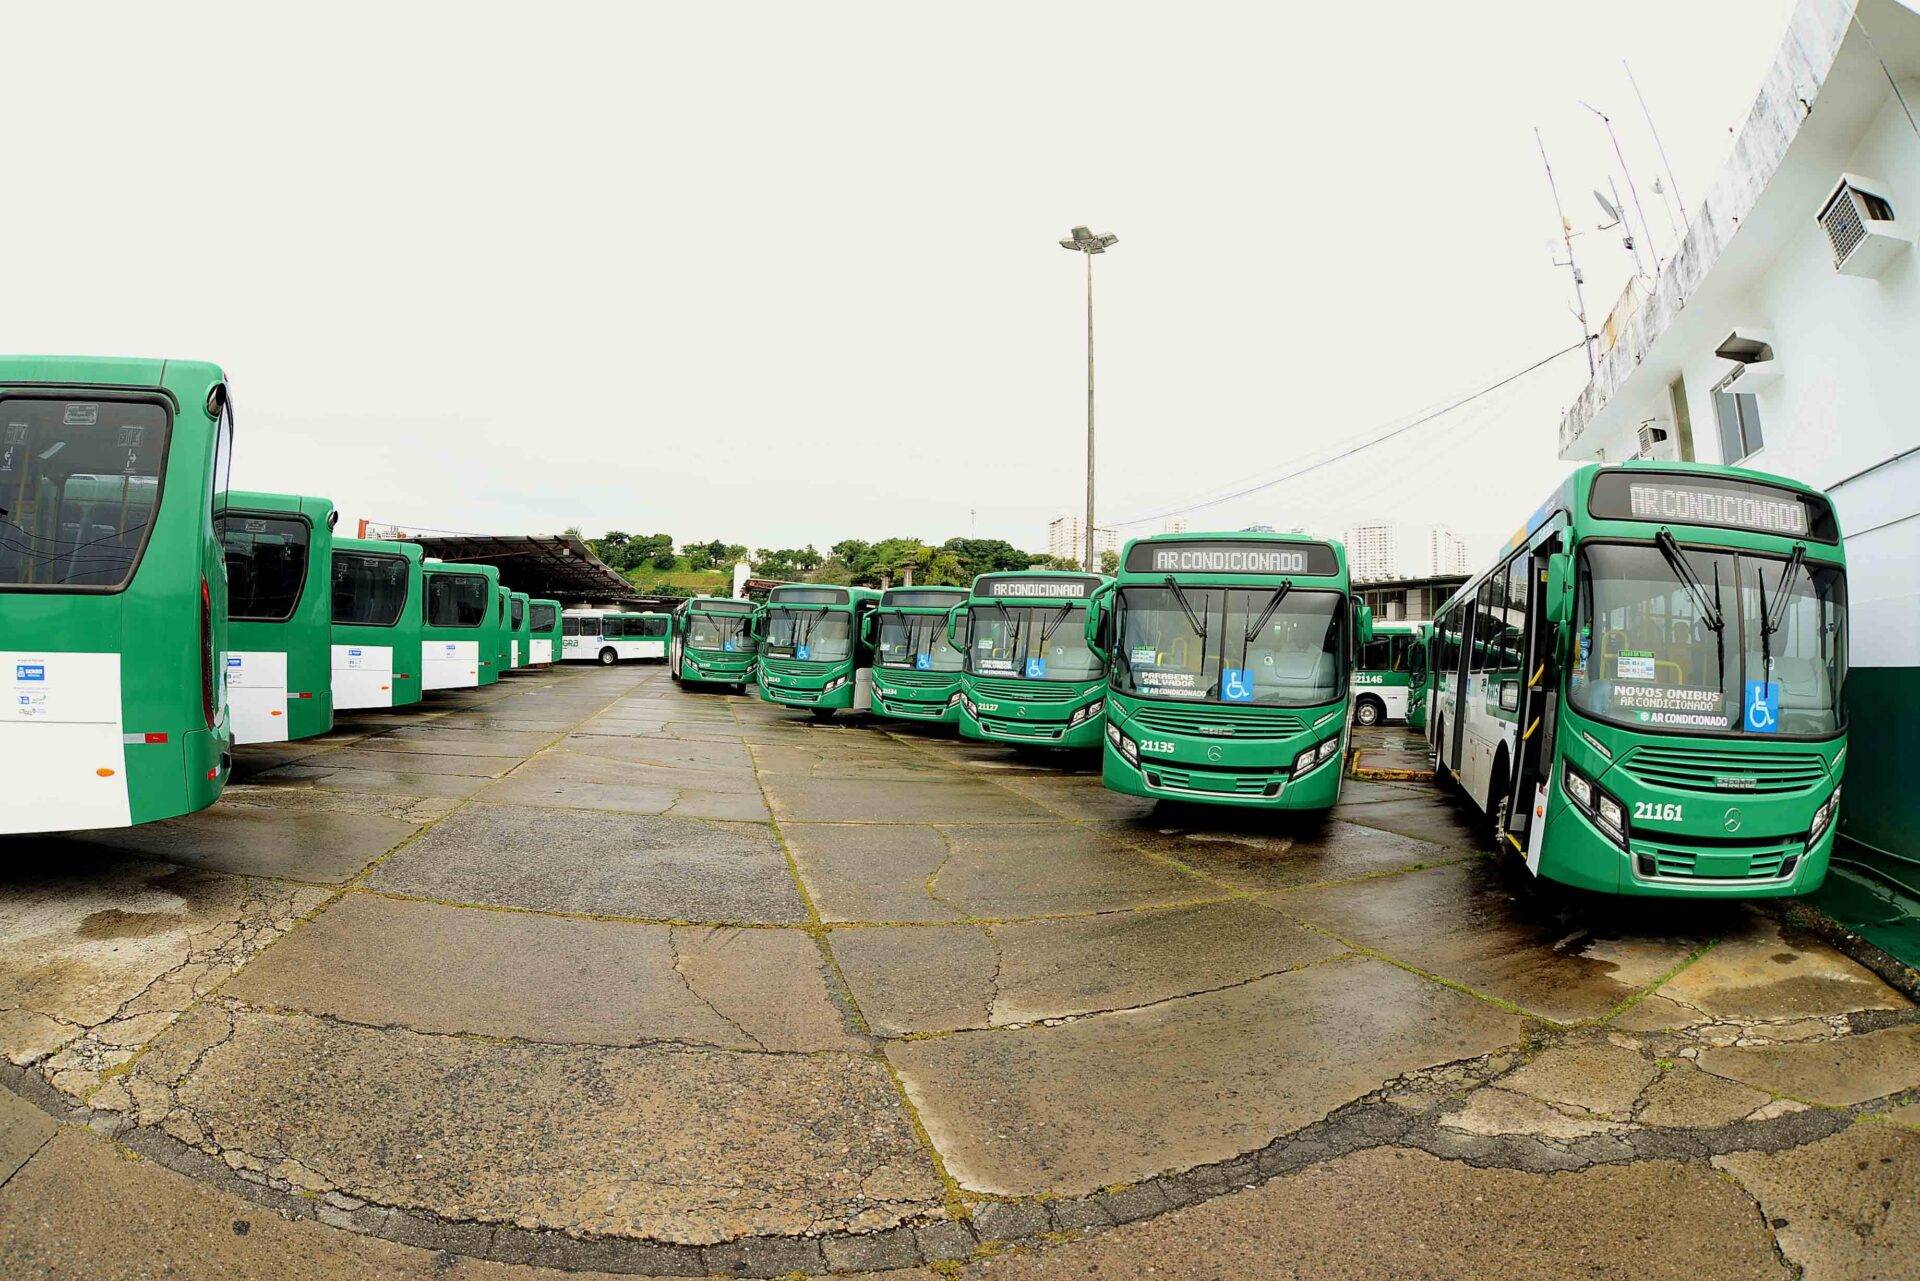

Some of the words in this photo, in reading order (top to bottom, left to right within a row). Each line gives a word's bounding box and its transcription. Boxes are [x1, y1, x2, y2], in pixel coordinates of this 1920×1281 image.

[1630, 486, 1659, 515] AR
[1662, 489, 1802, 531] CONDICIONADO
[1157, 551, 1179, 569] AR
[1181, 551, 1303, 571] CONDICIONADO
[993, 583, 1007, 596] AR
[1008, 584, 1085, 597] CONDICIONADO
[1141, 671, 1195, 681] PARABENS
[1143, 679, 1196, 688] SALVADOR
[1356, 675, 1383, 684] 21146
[1150, 687, 1159, 696] AR
[1159, 688, 1207, 698] CONDICIONADO
[1614, 685, 1663, 698] NOVOS
[1666, 688, 1721, 701] ONIBUS
[977, 702, 999, 711] 21127
[1620, 696, 1635, 707] AR
[1635, 698, 1714, 711] CONDICIONADO
[1650, 712, 1665, 723] AR
[1665, 713, 1728, 727] CONDICIONADO
[1140, 739, 1175, 754] 21135
[1633, 801, 1683, 822] 21161
